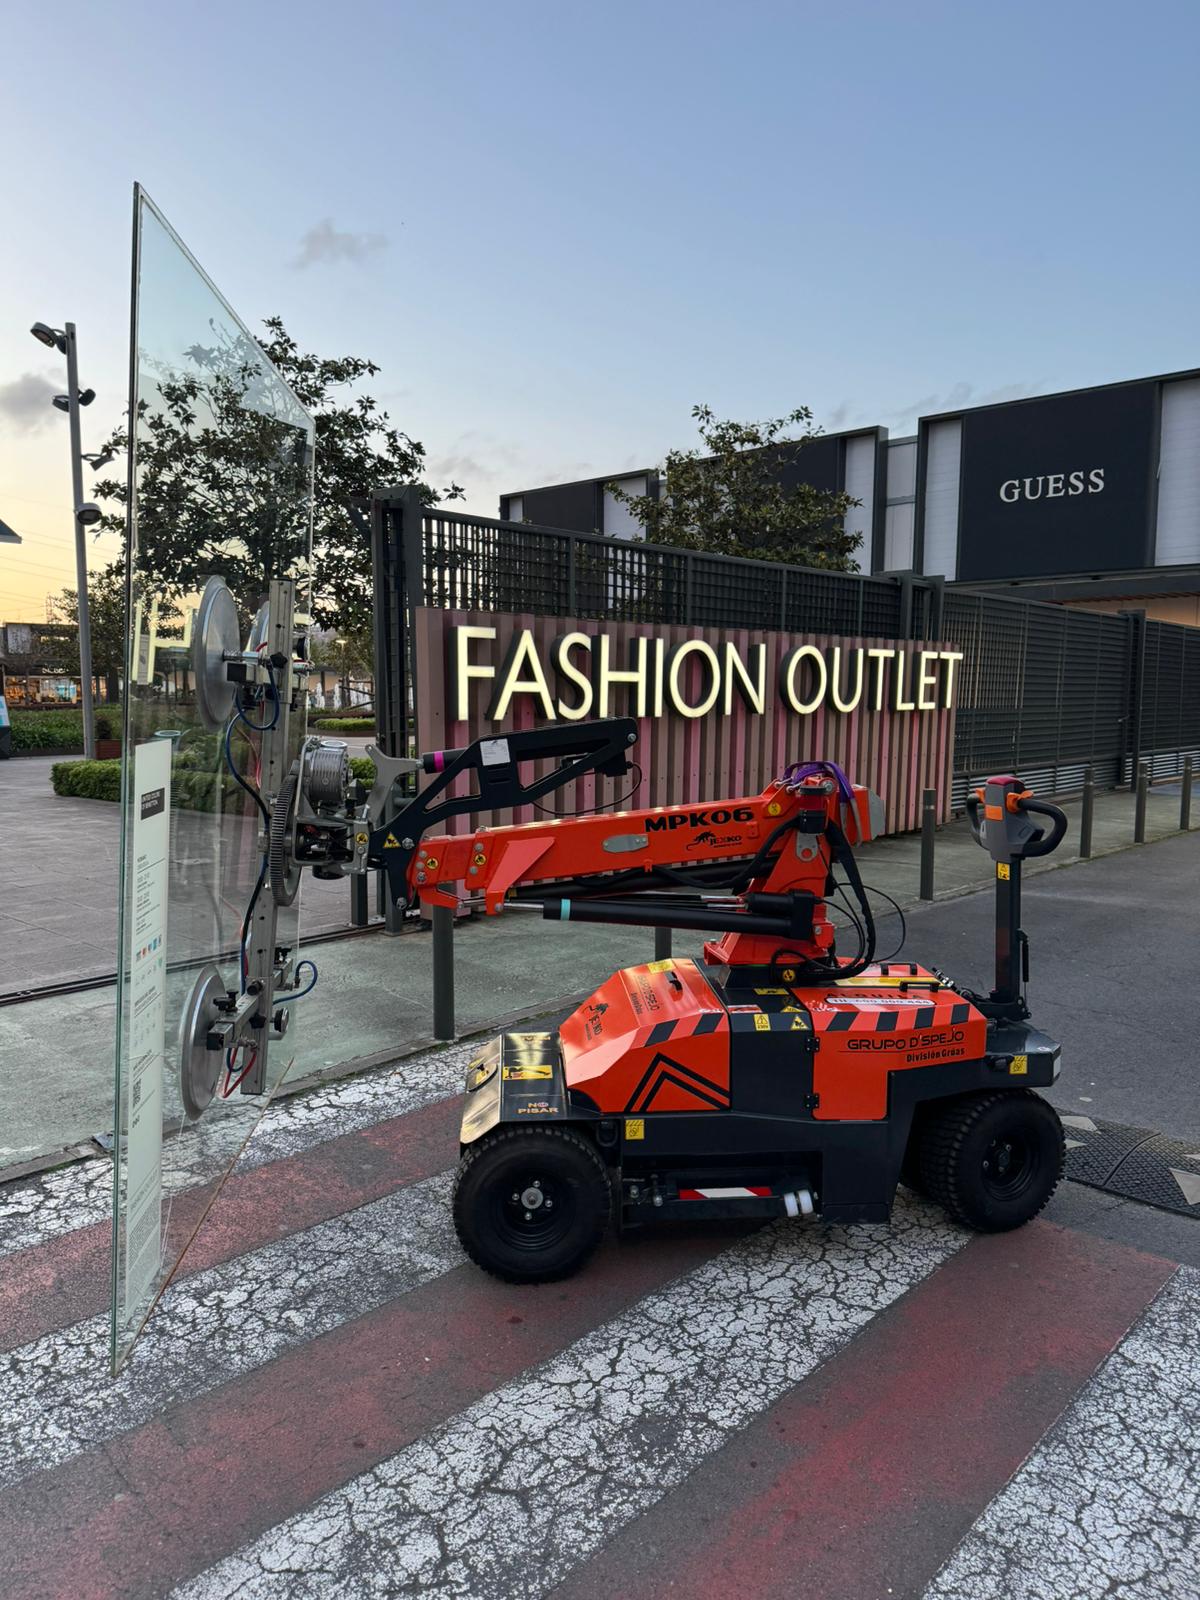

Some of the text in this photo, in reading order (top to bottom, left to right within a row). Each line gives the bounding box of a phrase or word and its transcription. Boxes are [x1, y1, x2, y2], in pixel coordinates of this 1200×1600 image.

[999, 468, 1105, 502] GUESS
[454, 625, 964, 721] FASHION OUTLET
[645, 807, 754, 832] MPK06
[847, 1038, 906, 1050] GRUPO
